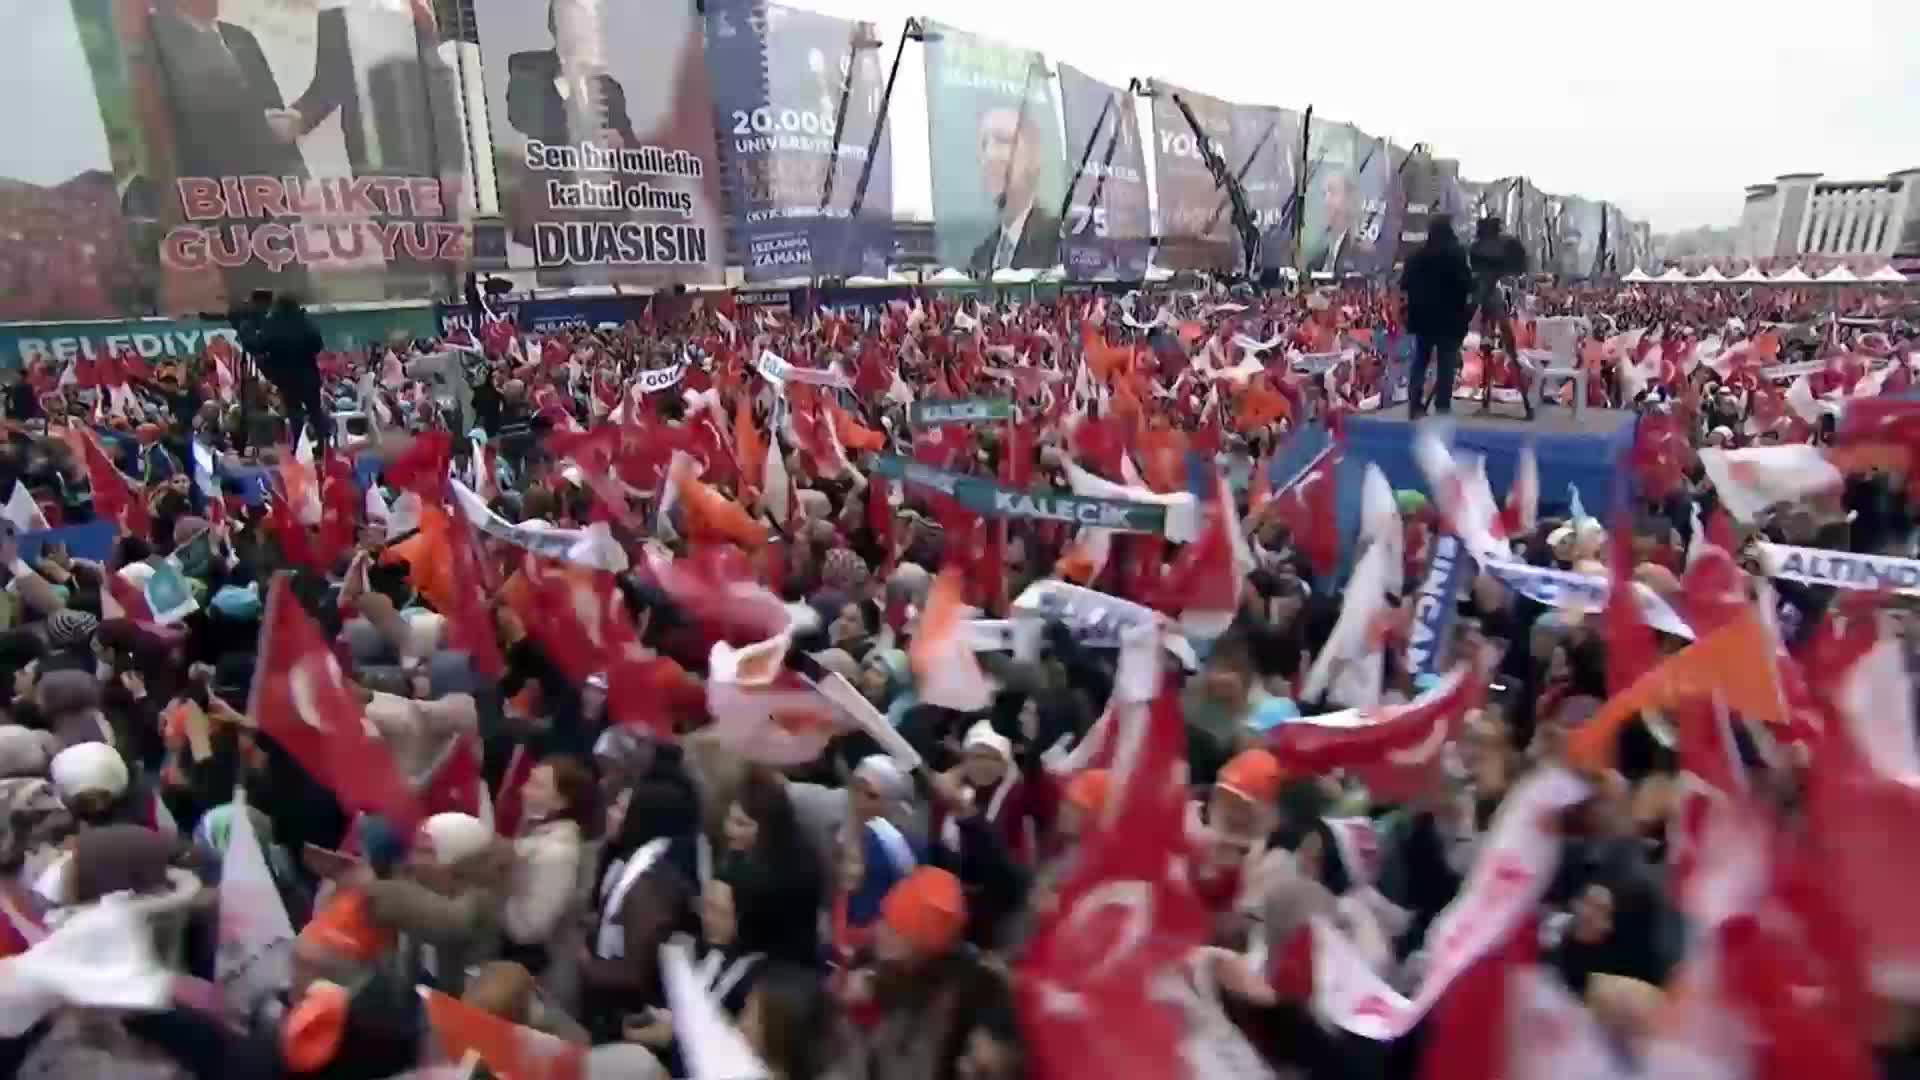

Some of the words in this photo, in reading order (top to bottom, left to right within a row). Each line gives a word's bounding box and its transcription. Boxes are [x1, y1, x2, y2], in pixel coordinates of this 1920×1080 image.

[526, 140, 578, 171] Sen
[622, 148, 703, 177] milletin
[549, 180, 621, 210] kabul
[627, 182, 693, 217] olmuş
[536, 222, 706, 265] DUASISIN
